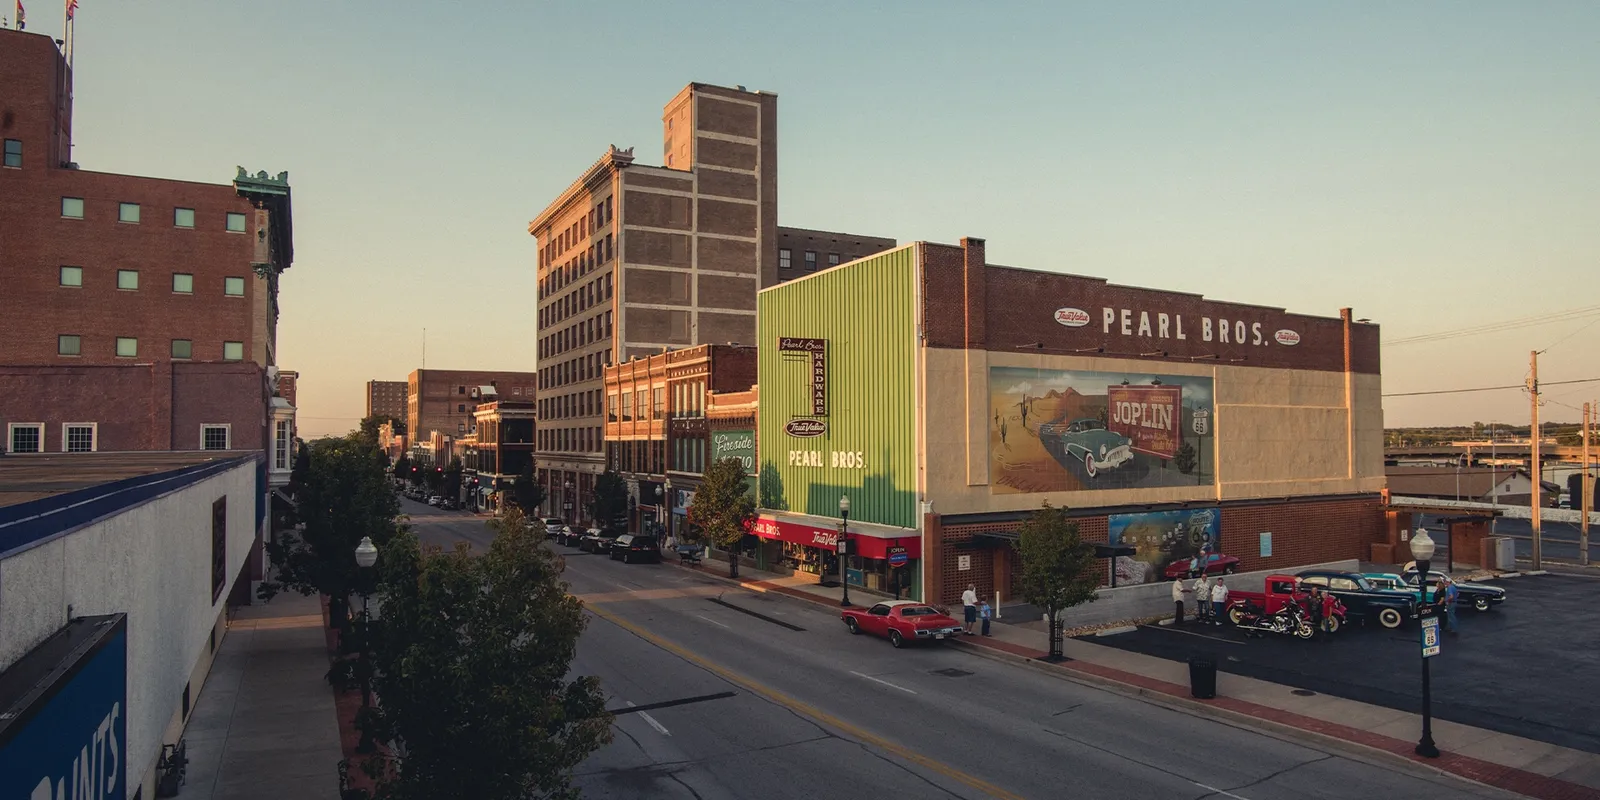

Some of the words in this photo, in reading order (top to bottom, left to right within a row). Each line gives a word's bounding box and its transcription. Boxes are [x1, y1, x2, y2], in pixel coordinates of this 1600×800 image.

[1103, 307, 1186, 340] PEARL
[1202, 316, 1268, 346] BROS.
[815, 352, 824, 413] HARDWARE
[1113, 401, 1174, 431] JOPLIN
[1195, 422, 1204, 433] 66
[715, 434, 752, 460] Fireside
[789, 450, 824, 467] PEARL
[832, 451, 867, 469] BROS.
[1192, 525, 1210, 543] 66
